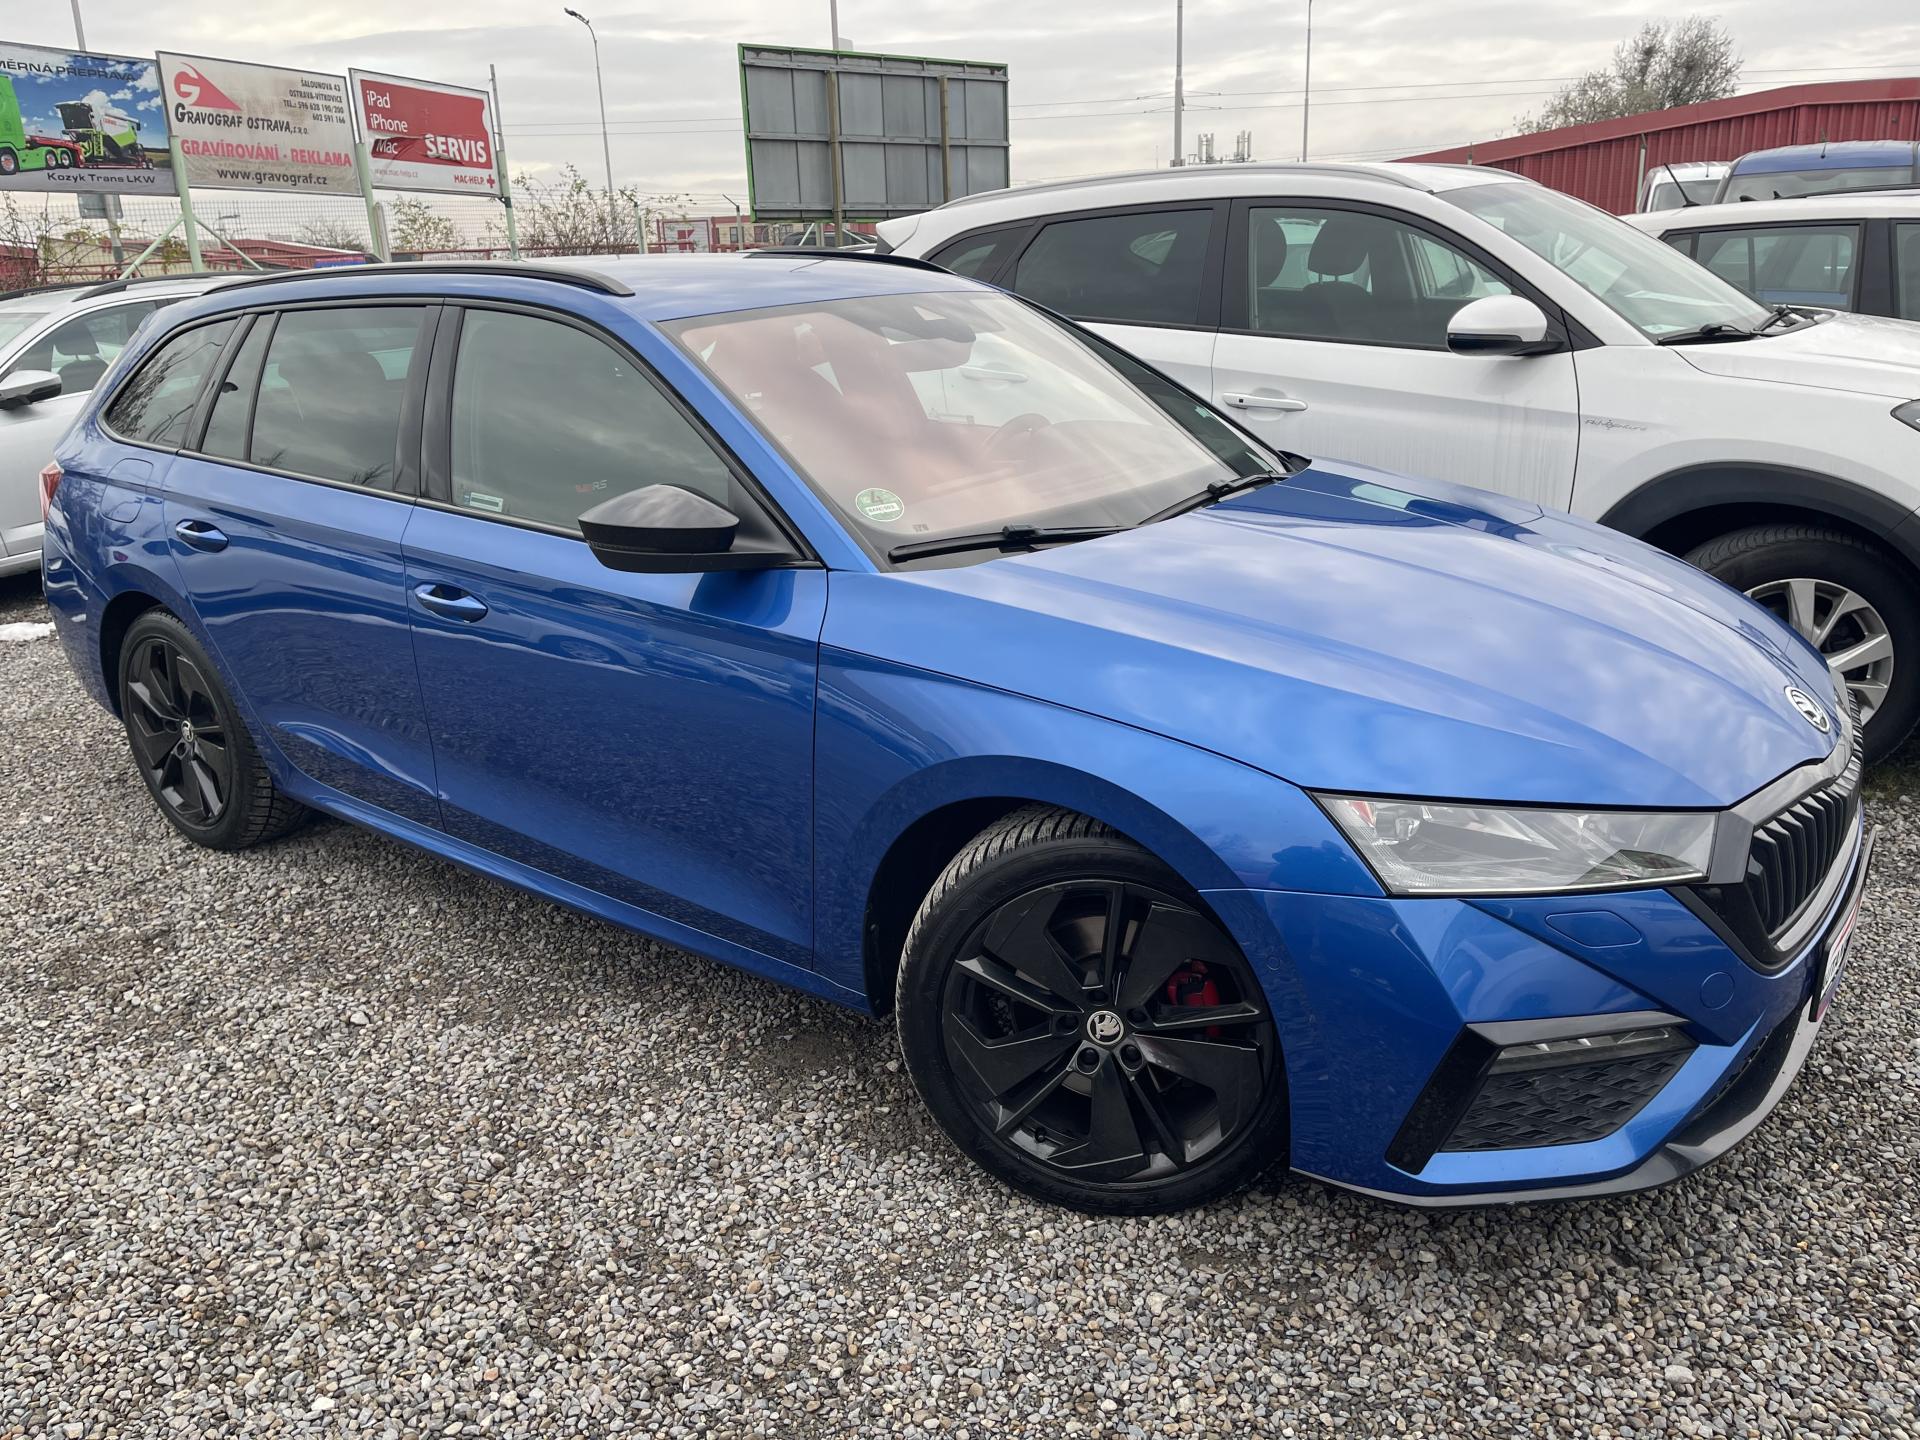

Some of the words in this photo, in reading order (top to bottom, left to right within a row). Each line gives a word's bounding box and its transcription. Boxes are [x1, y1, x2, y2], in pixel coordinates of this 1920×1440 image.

[55, 64, 137, 81] PŘEPRAVA
[366, 90, 391, 109] iPad
[174, 102, 243, 128] GRAVOGRAF
[370, 113, 408, 133] iPhone
[180, 139, 280, 161] GRAVÍROVÁNÍ
[291, 148, 352, 167] REKLAMA
[376, 140, 399, 155] Mac
[424, 133, 487, 163] SERVIS
[47, 172, 86, 184] Kozyk
[88, 174, 124, 183] Trans
[126, 175, 156, 184] LKW
[216, 169, 328, 187] www.gravograf.cz
[592, 479, 608, 491] RS
